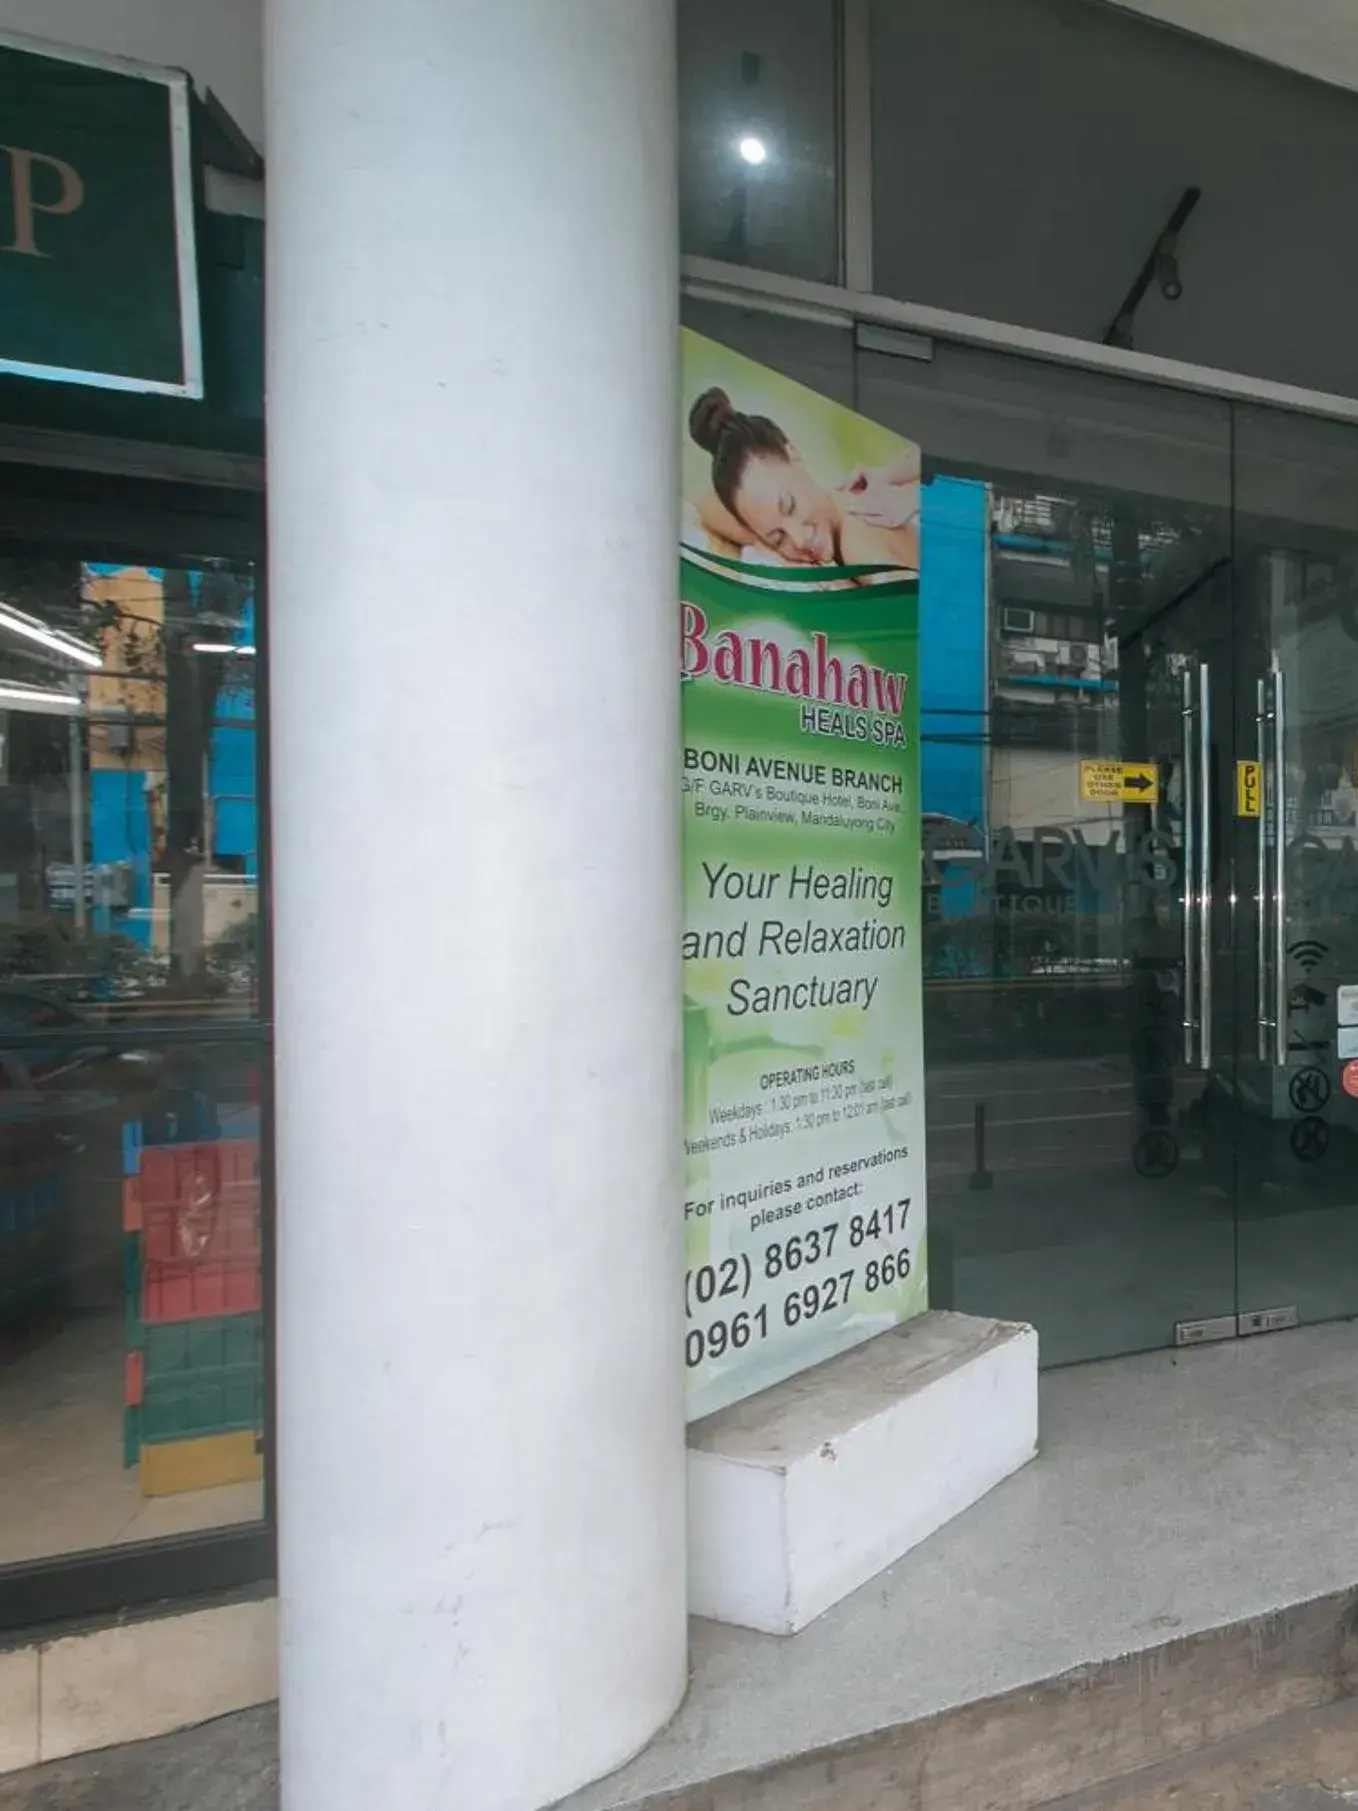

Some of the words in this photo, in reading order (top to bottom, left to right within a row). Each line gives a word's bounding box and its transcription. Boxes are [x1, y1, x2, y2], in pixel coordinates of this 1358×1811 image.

[680, 601, 907, 715] Banahaw
[802, 706, 867, 740] HEALS
[874, 721, 906, 747] SPA
[684, 747, 740, 775] BONI
[746, 757, 827, 785] AVENUE
[832, 768, 903, 794] BRANCH
[1244, 765, 1257, 812] PULL
[701, 861, 781, 899] Your
[788, 864, 894, 908] Healing
[682, 920, 748, 960] and
[758, 918, 906, 957] Relaxation
[727, 975, 880, 1016] Sanctuary
[759, 1065, 820, 1090] OPERATING
[822, 1059, 856, 1079] HOURS
[684, 1198, 716, 1221] For
[720, 1178, 793, 1212] inquiries
[796, 1167, 824, 1189] and
[828, 1145, 909, 1180] reservations
[750, 1200, 801, 1232] please
[806, 1181, 863, 1210] contact:
[685, 1252, 751, 1319] (02)
[764, 1223, 839, 1279] 8637
[849, 1198, 911, 1248] 8417
[685, 1303, 768, 1368] 0961
[783, 1268, 855, 1327] 6927
[864, 1248, 911, 1293] 866
